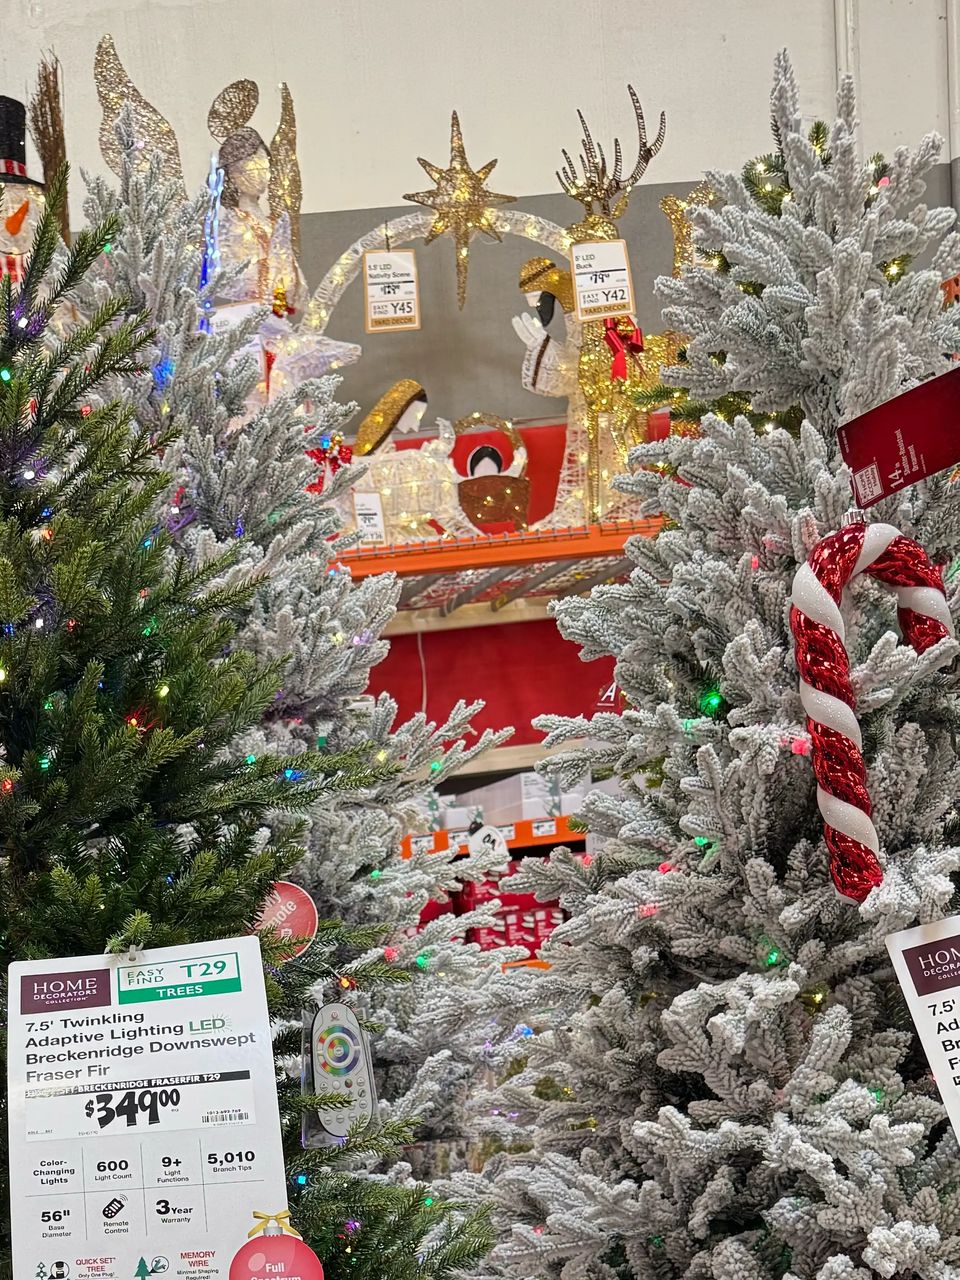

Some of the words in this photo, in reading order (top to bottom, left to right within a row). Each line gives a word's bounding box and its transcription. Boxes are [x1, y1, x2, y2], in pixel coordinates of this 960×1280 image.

[602, 289, 626, 302] Y42
[390, 302, 413, 314] Y45
[604, 304, 626, 312] DECOR
[894, 428, 911, 476] Shatter-Resistant
[908, 444, 920, 472] Ornament
[888, 470, 904, 490] 14
[918, 948, 960, 970] HOM
[128, 968, 164, 979] EASY
[180, 960, 228, 979] T29
[34, 978, 98, 994] HOME
[128, 976, 164, 986] FIND
[33, 988, 97, 1000] DECORATORS
[156, 984, 204, 998] TREES
[45, 996, 86, 1005] COLLECTION
[928, 999, 956, 1016] 7.5'
[26, 1018, 54, 1033] 7.5'
[60, 1012, 144, 1030] Twinkling
[26, 1030, 104, 1049] Adaptive
[110, 1022, 184, 1042] Lighting
[190, 1018, 226, 1033] LED
[26, 1043, 144, 1065] Breckenridge
[150, 1031, 256, 1054] Downswept
[26, 1067, 82, 1083] Fraser
[88, 1064, 110, 1078] Fir
[78, 1080, 150, 1093] BRECKENRIDGE
[151, 1074, 200, 1086] FRASERFIR
[203, 1073, 221, 1082] T29
[40, 1160, 68, 1168] Color-
[162, 1156, 182, 1168] 9+
[207, 1150, 256, 1166] 5,010
[96, 1159, 129, 1172] 600
[238, 1164, 252, 1172] Tips
[33, 1167, 75, 1178] Changing
[94, 1174, 112, 1182] Light
[112, 1172, 132, 1180] Count
[164, 1168, 181, 1178] Light
[40, 1176, 68, 1186] Lights
[156, 1174, 190, 1184] Functions
[156, 1200, 170, 1215] 3
[171, 1206, 194, 1215] Year
[40, 1210, 70, 1222] 56"
[160, 1216, 191, 1225] Warranty
[103, 1220, 129, 1228] Remote
[42, 1230, 72, 1238] Diameter
[104, 1226, 129, 1235] Control
[180, 1250, 216, 1260] MEMORY
[76, 1258, 98, 1266] QUICK
[188, 1259, 209, 1268] WIRE
[265, 1262, 285, 1274] Full
[197, 1268, 219, 1276] Shaping
